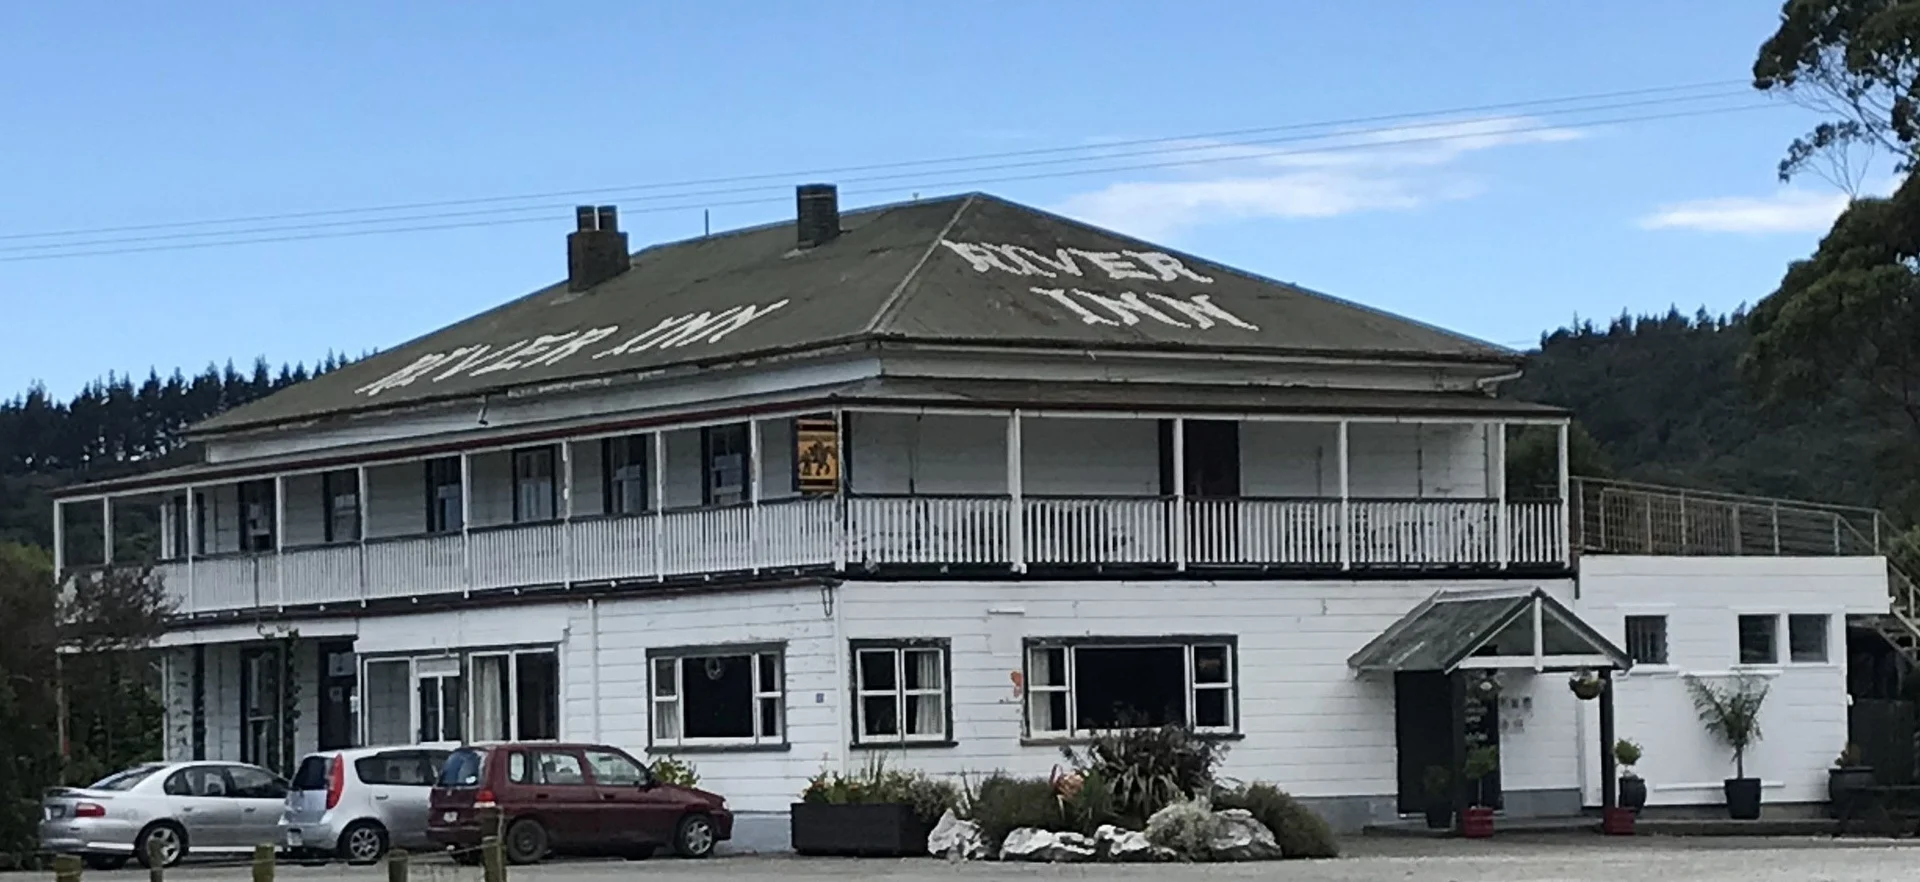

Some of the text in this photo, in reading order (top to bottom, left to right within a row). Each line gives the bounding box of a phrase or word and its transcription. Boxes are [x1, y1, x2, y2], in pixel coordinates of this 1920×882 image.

[941, 238, 1214, 284] RIVER
[1029, 286, 1259, 332] INN
[354, 298, 790, 396] RIVER INN
